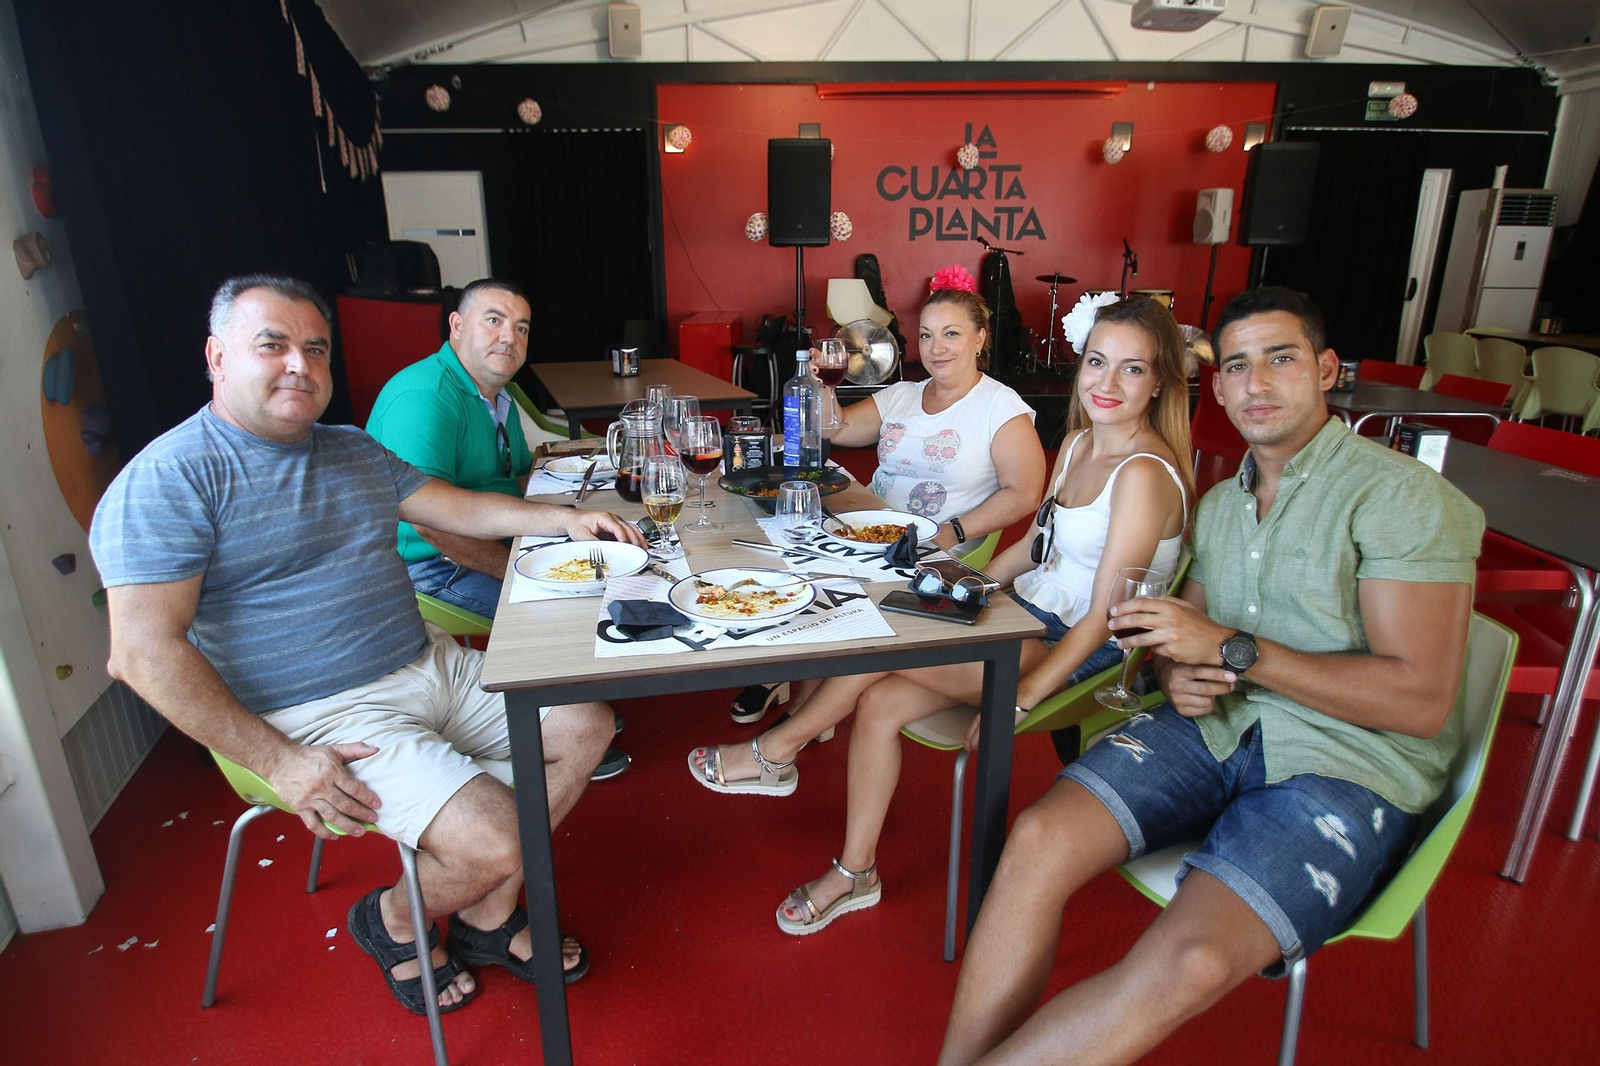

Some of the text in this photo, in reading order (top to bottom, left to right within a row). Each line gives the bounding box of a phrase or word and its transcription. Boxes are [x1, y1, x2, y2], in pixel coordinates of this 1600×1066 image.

[876, 165, 1026, 201] CUARTA
[908, 206, 1047, 241] PLANTA
[766, 634, 781, 642] UN
[781, 622, 819, 637] ESPACIO
[833, 608, 864, 620] ALTURA
